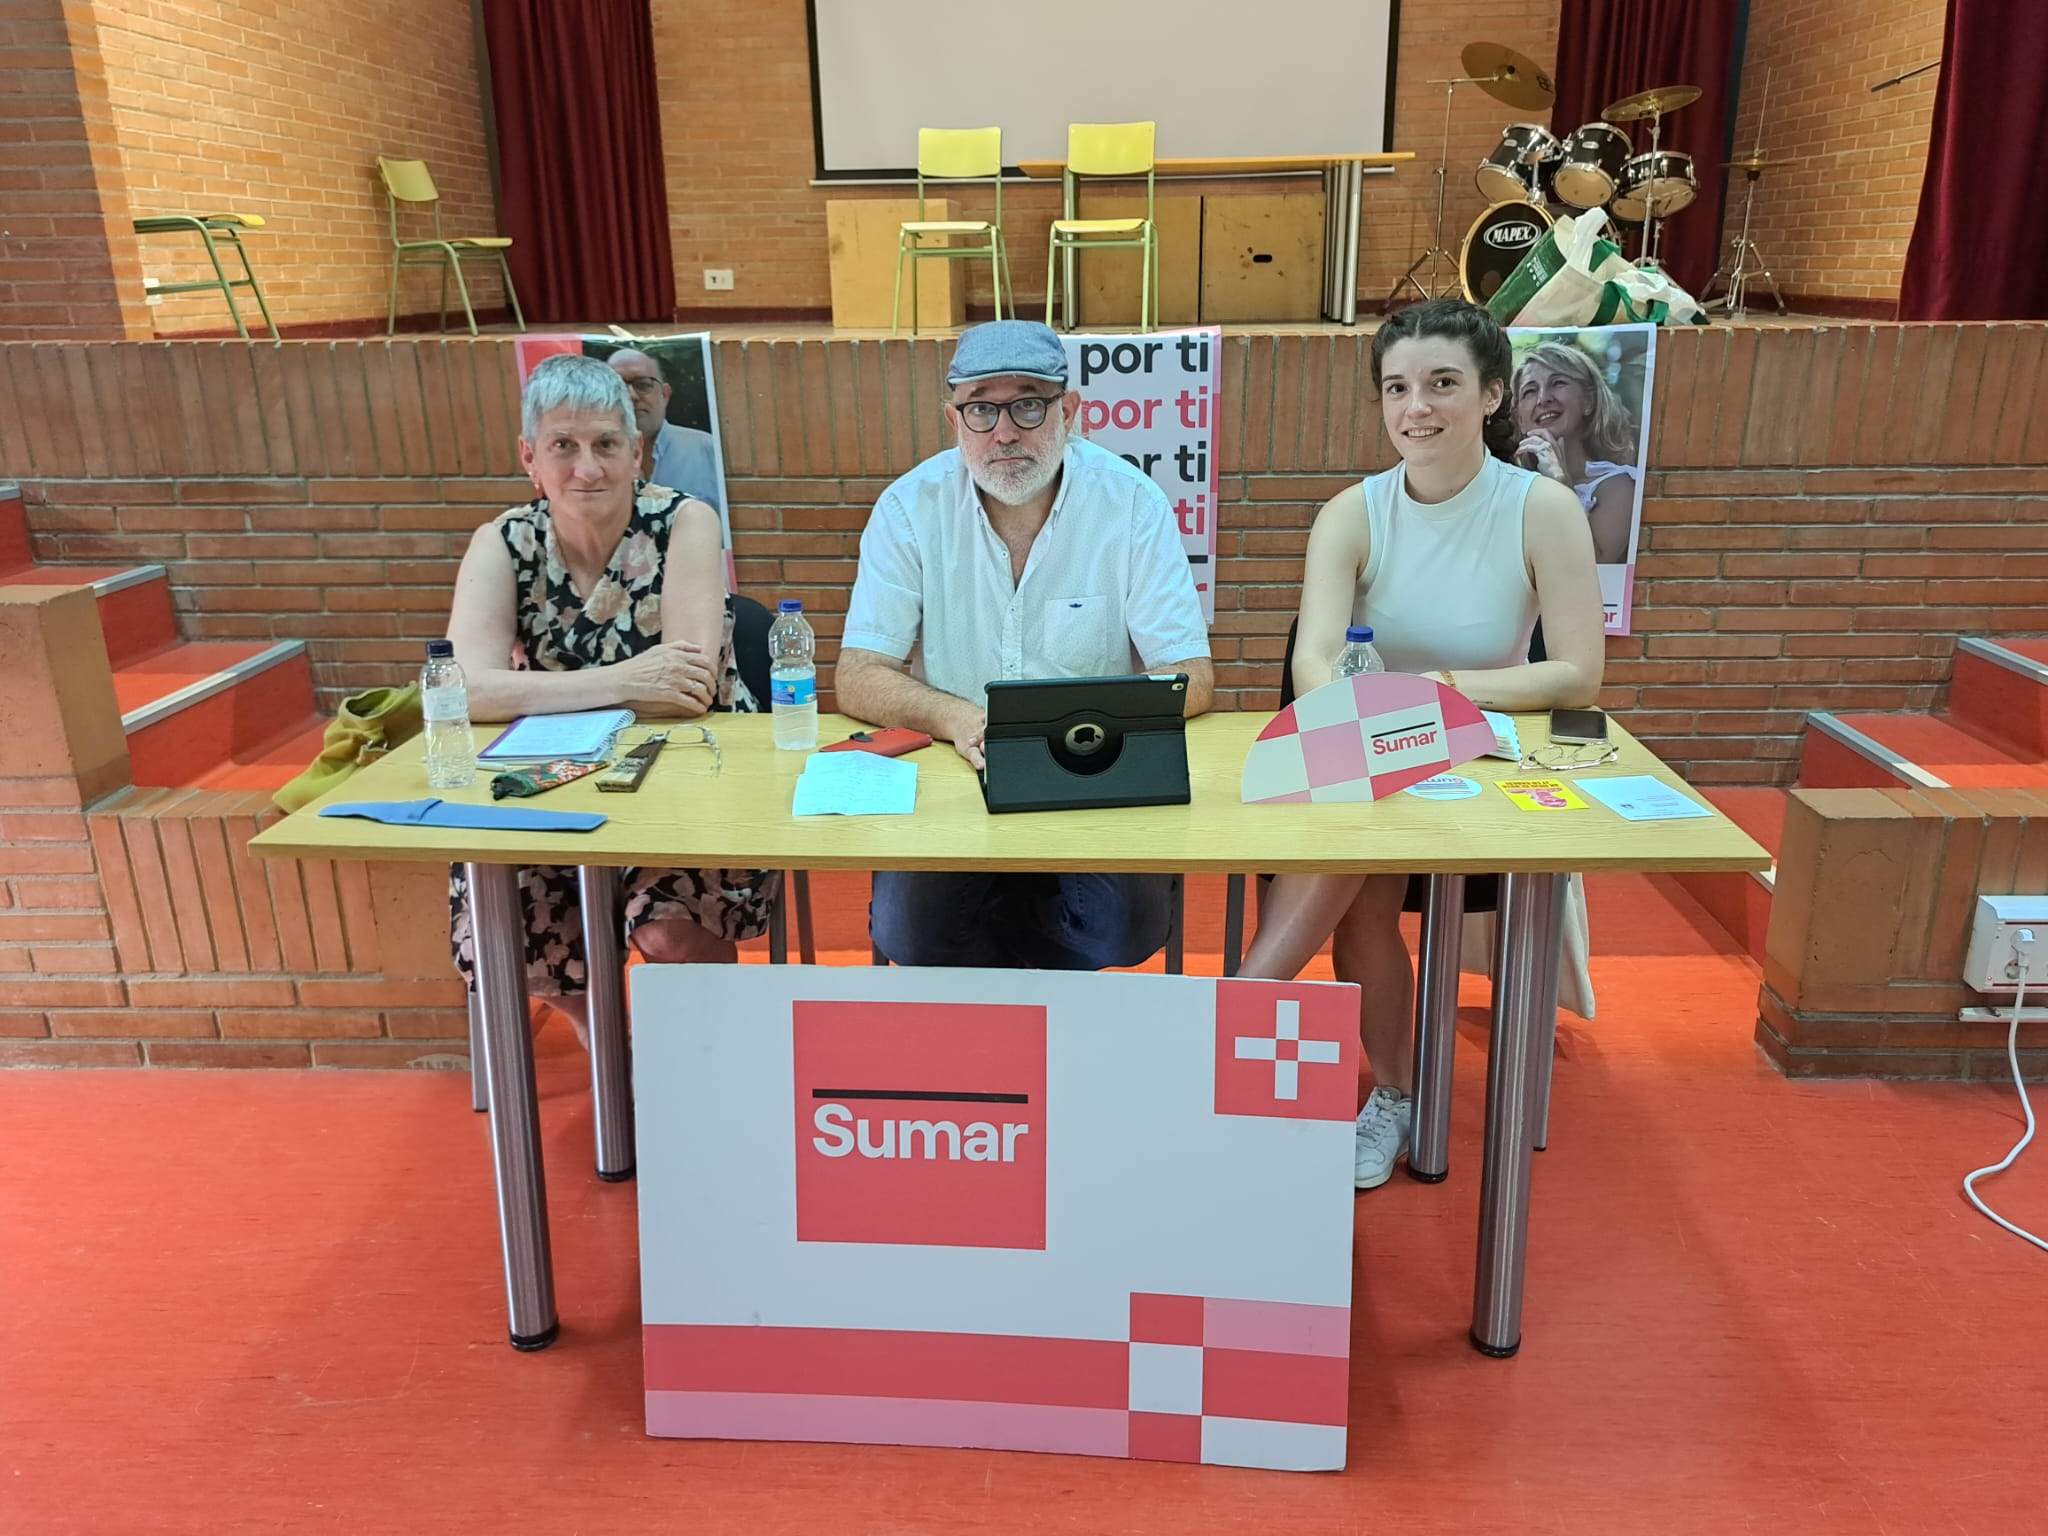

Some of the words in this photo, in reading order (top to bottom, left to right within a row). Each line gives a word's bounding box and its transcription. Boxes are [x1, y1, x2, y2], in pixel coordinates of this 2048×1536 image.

[1080, 342, 1163, 386] por
[1176, 332, 1209, 373] ti
[1080, 398, 1162, 437] por
[1175, 385, 1208, 429] ti
[1174, 440, 1207, 482] ti
[1173, 494, 1206, 536] ti
[1371, 729, 1438, 756] Sumar
[812, 1103, 1029, 1162] Sumar
